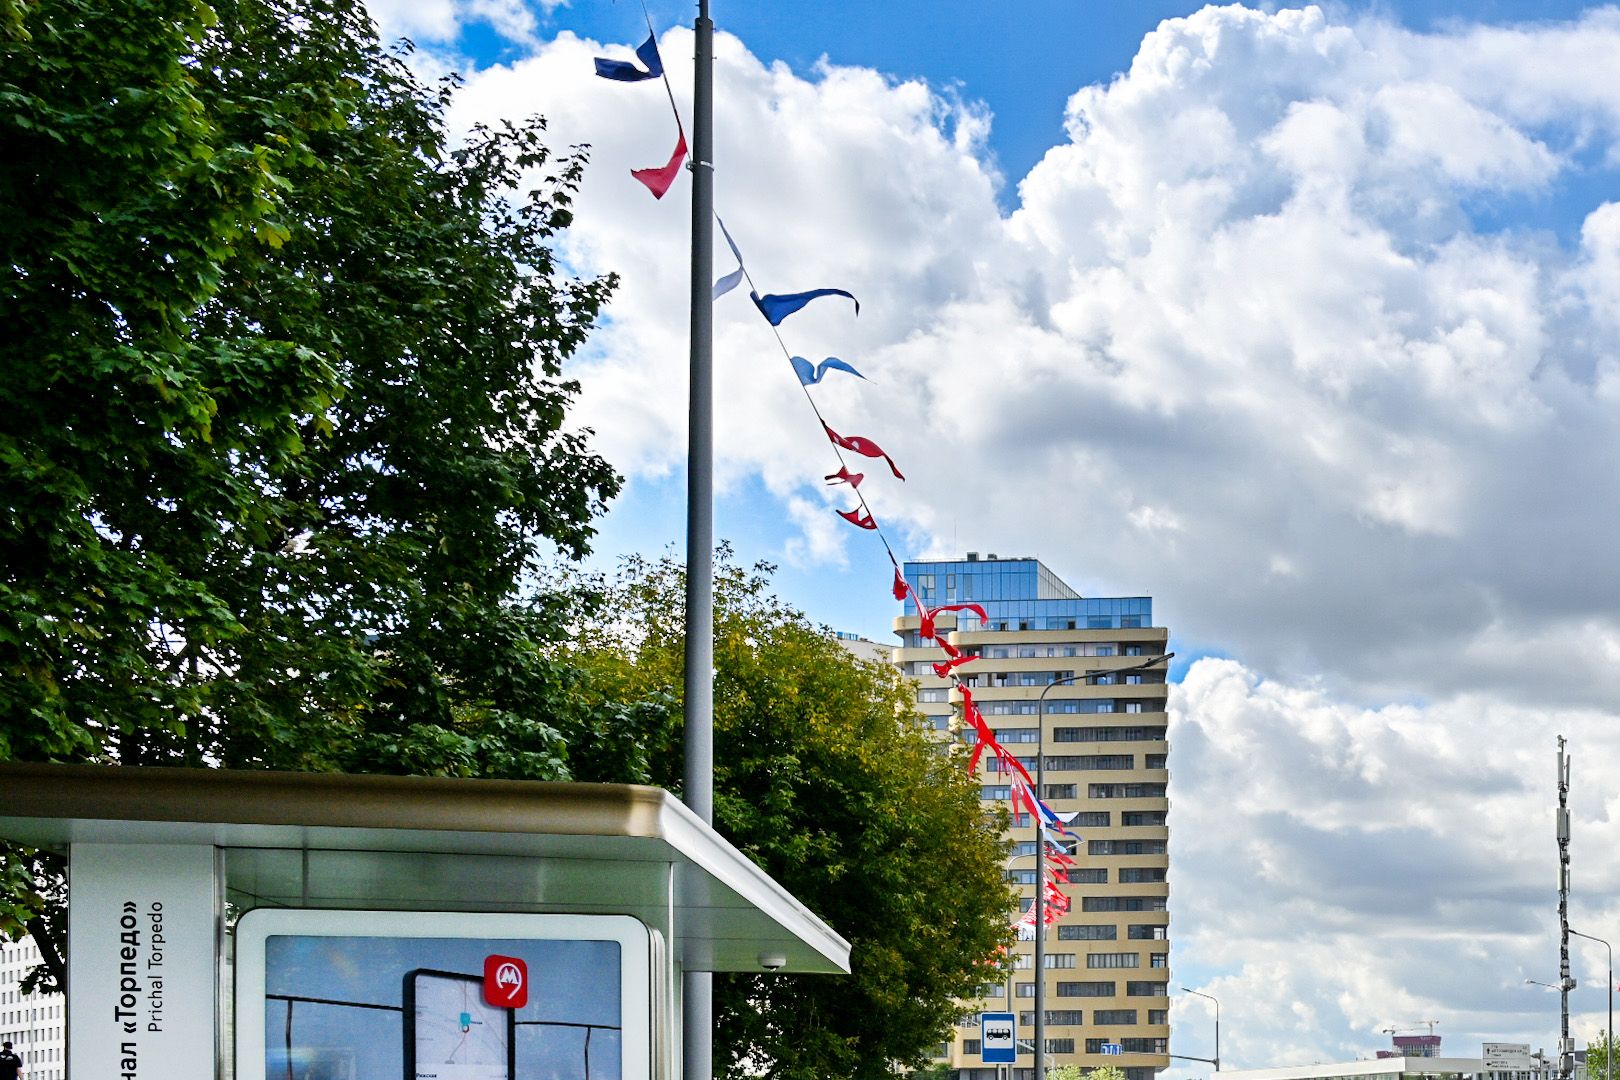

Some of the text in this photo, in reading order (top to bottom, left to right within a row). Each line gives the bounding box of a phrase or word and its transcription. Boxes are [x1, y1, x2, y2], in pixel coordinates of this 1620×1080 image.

[114, 901, 142, 1034] «Торпедо»
[147, 901, 166, 1032] Prichal Torpedo
